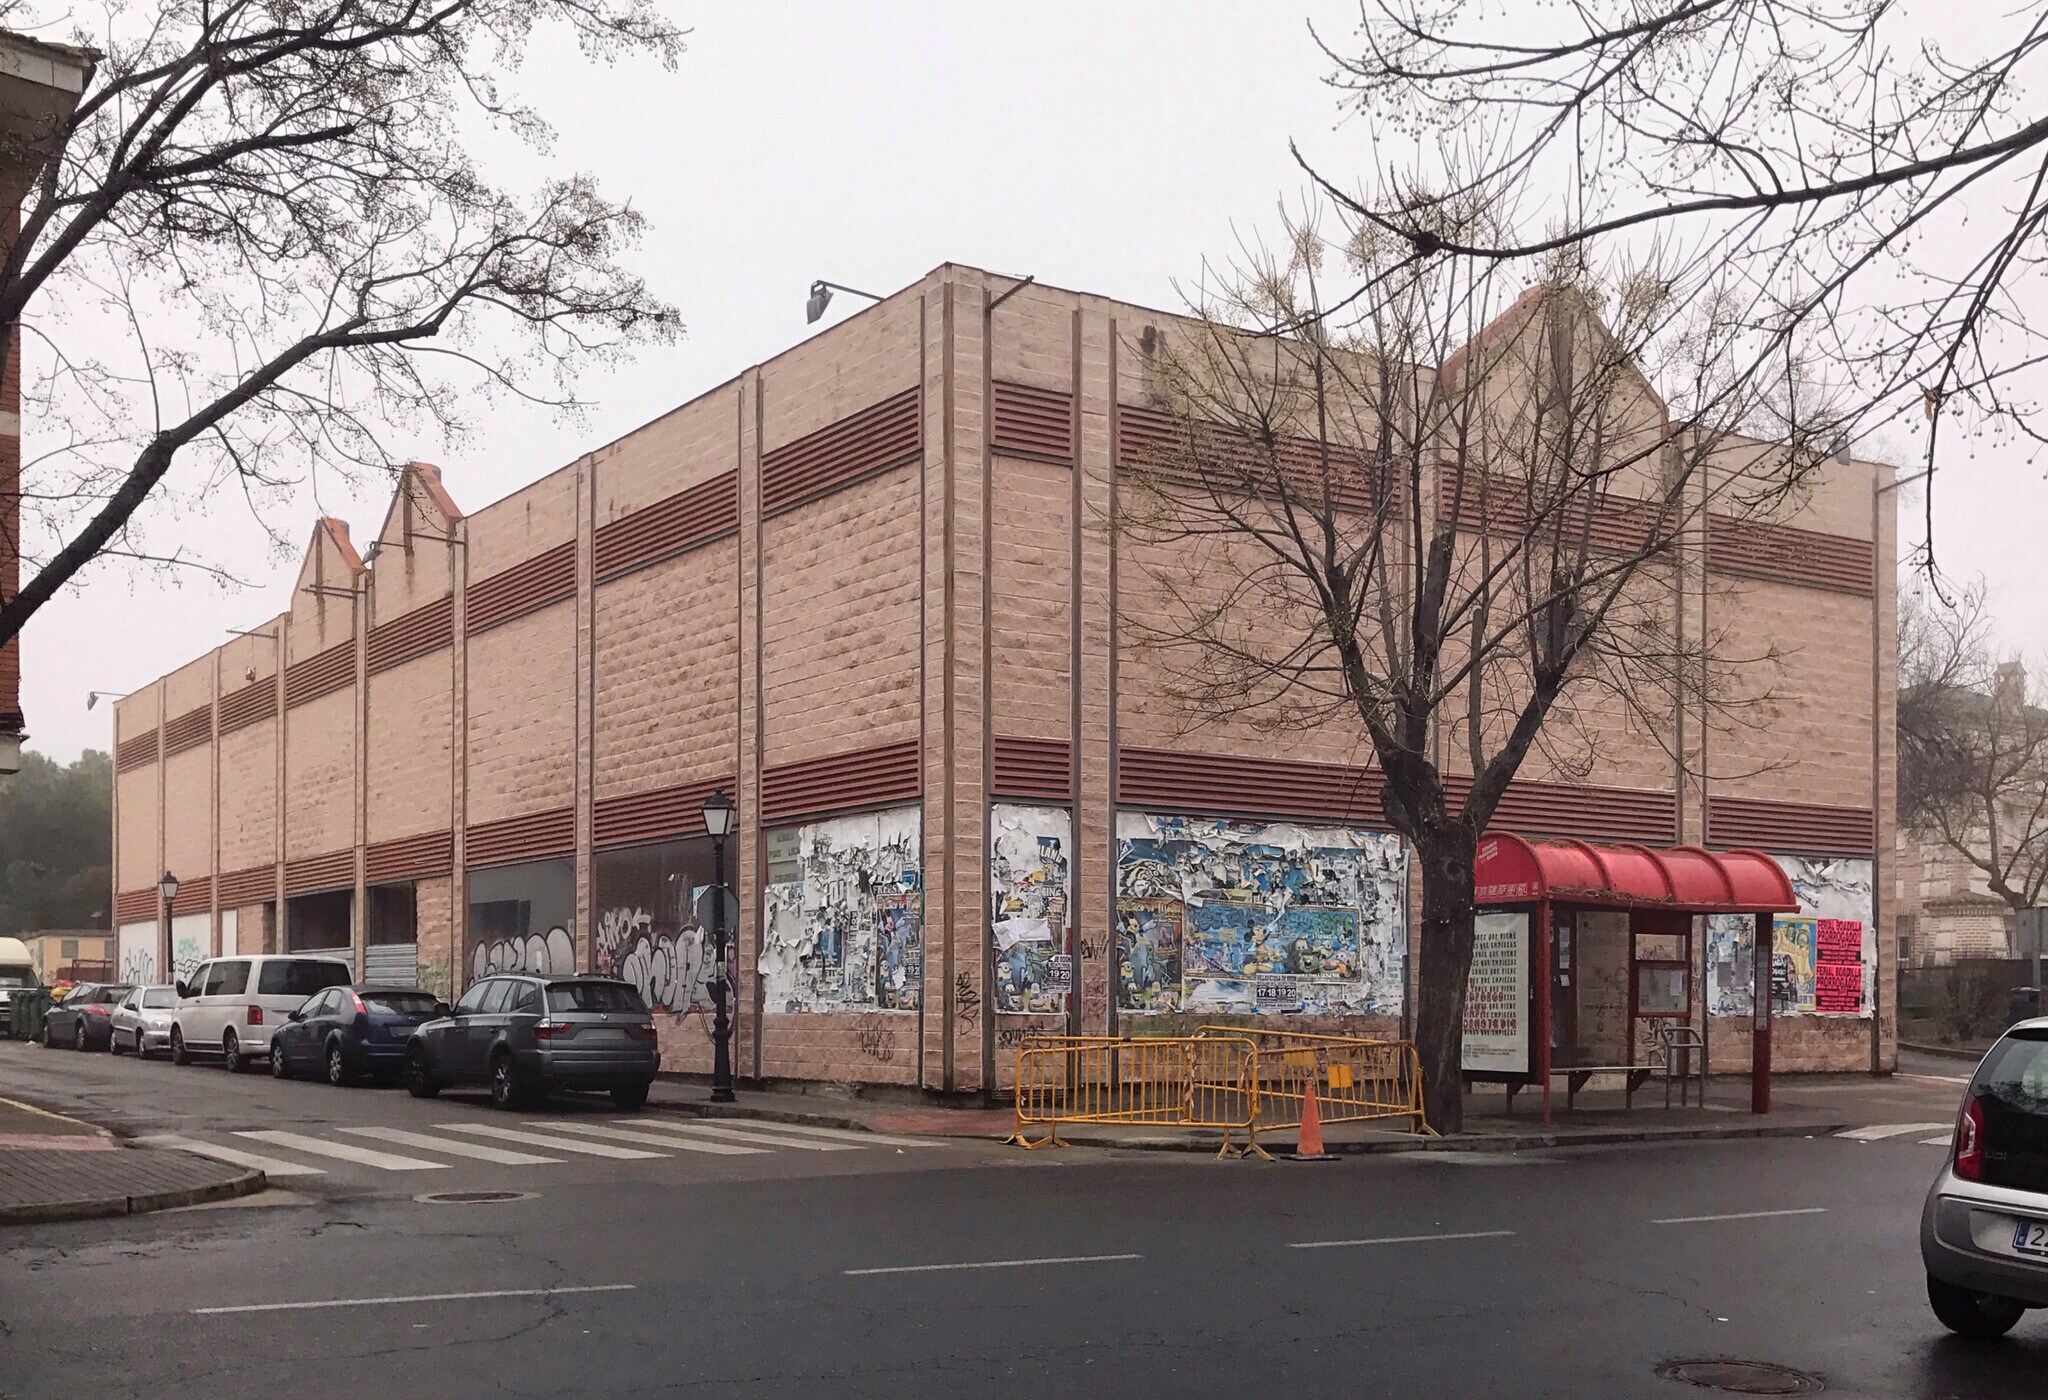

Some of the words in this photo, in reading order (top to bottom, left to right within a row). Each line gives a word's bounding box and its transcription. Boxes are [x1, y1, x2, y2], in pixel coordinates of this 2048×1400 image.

[1060, 970, 1070, 979] 20
[1267, 989, 1276, 997] 18
[1287, 989, 1296, 997] 20
